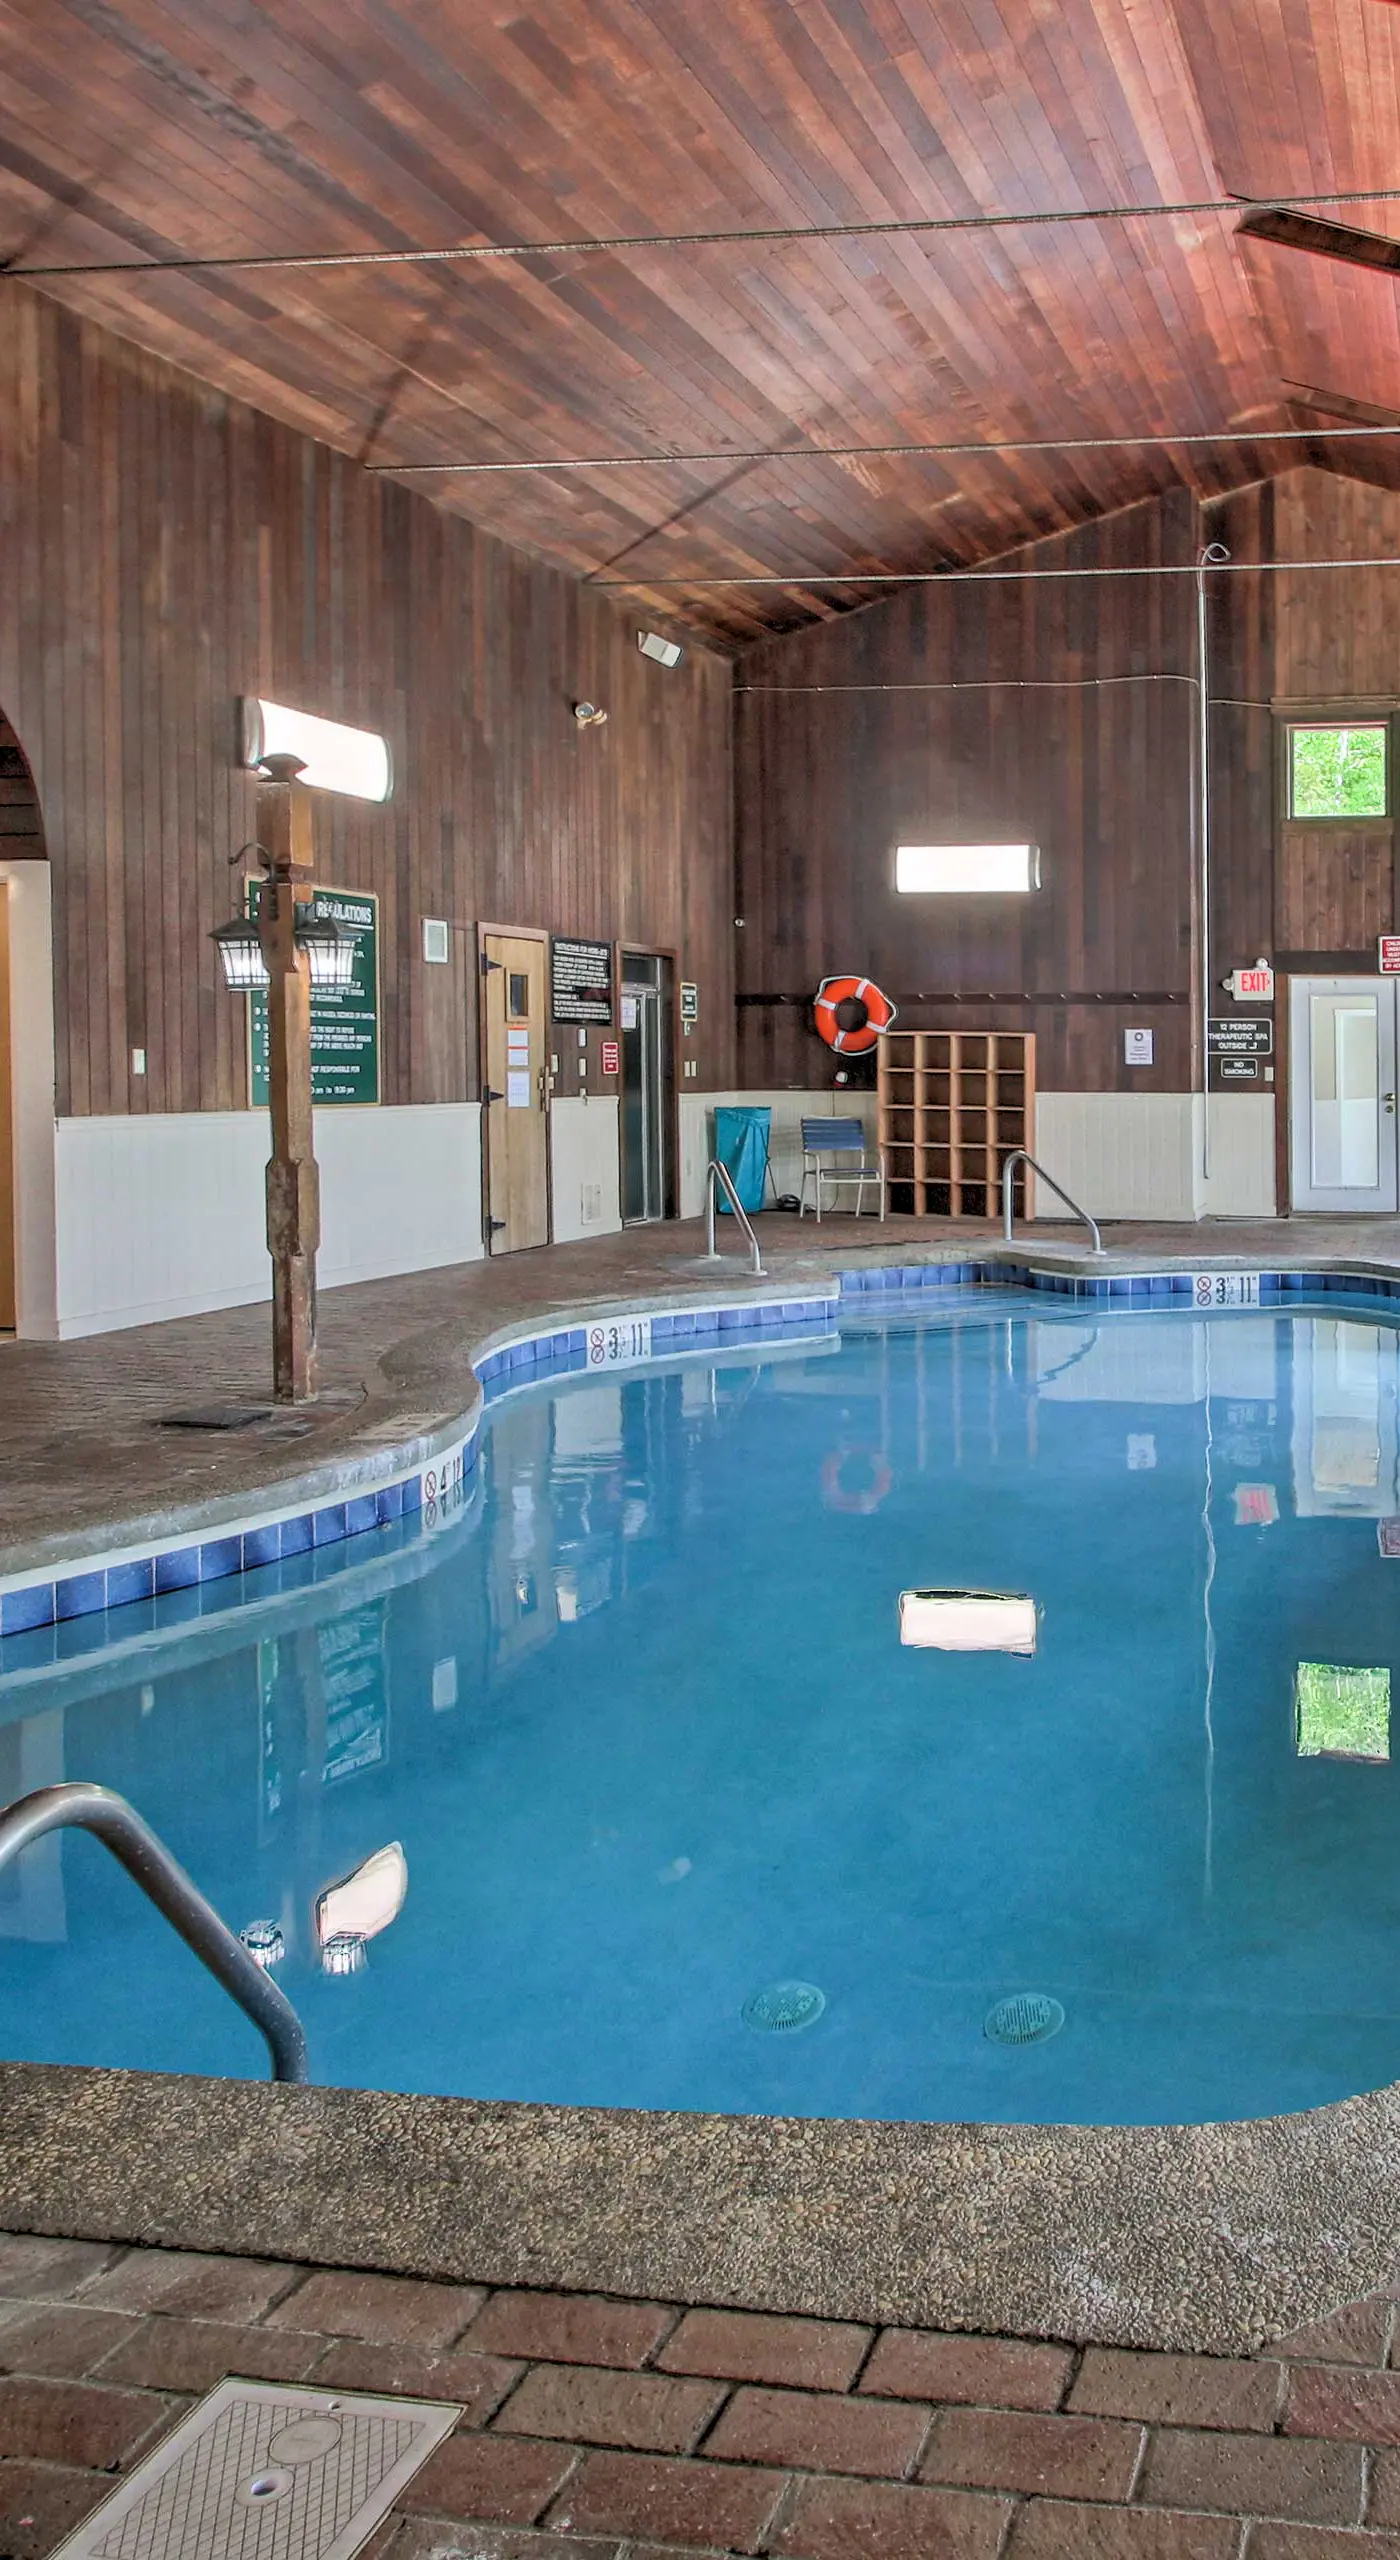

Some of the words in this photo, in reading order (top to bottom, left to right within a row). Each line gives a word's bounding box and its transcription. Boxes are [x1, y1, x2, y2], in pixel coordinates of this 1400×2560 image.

[1241, 972, 1267, 992] EXIT
[1220, 1023, 1228, 1031] 12
[1229, 1023, 1257, 1031] PERSON
[1208, 1032, 1253, 1040] THERAPEUTIC
